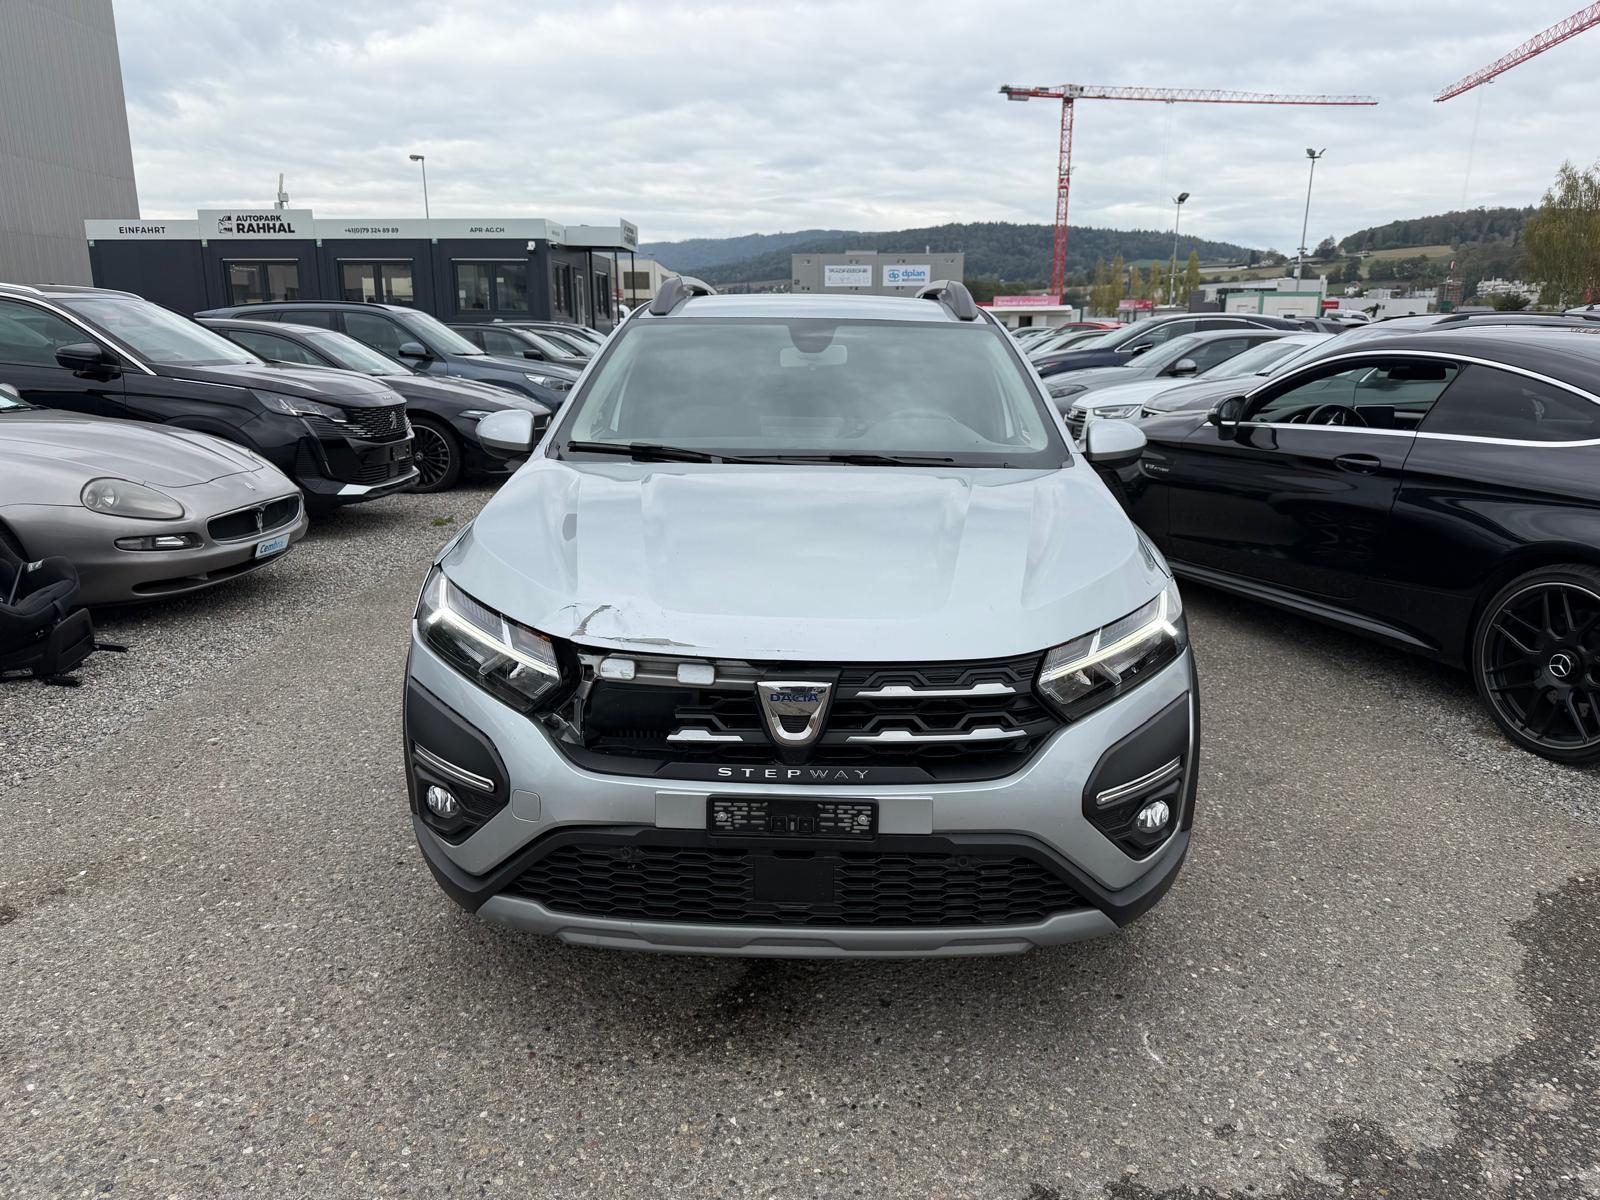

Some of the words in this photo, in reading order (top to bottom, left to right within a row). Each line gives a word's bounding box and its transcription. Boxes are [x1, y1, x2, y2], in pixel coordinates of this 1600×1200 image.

[119, 226, 166, 234] EINFAHRT
[236, 223, 295, 233] RAHHAL
[901, 269, 926, 278] dplan
[769, 693, 819, 702] DACIA
[718, 767, 869, 779] STEPWAY
